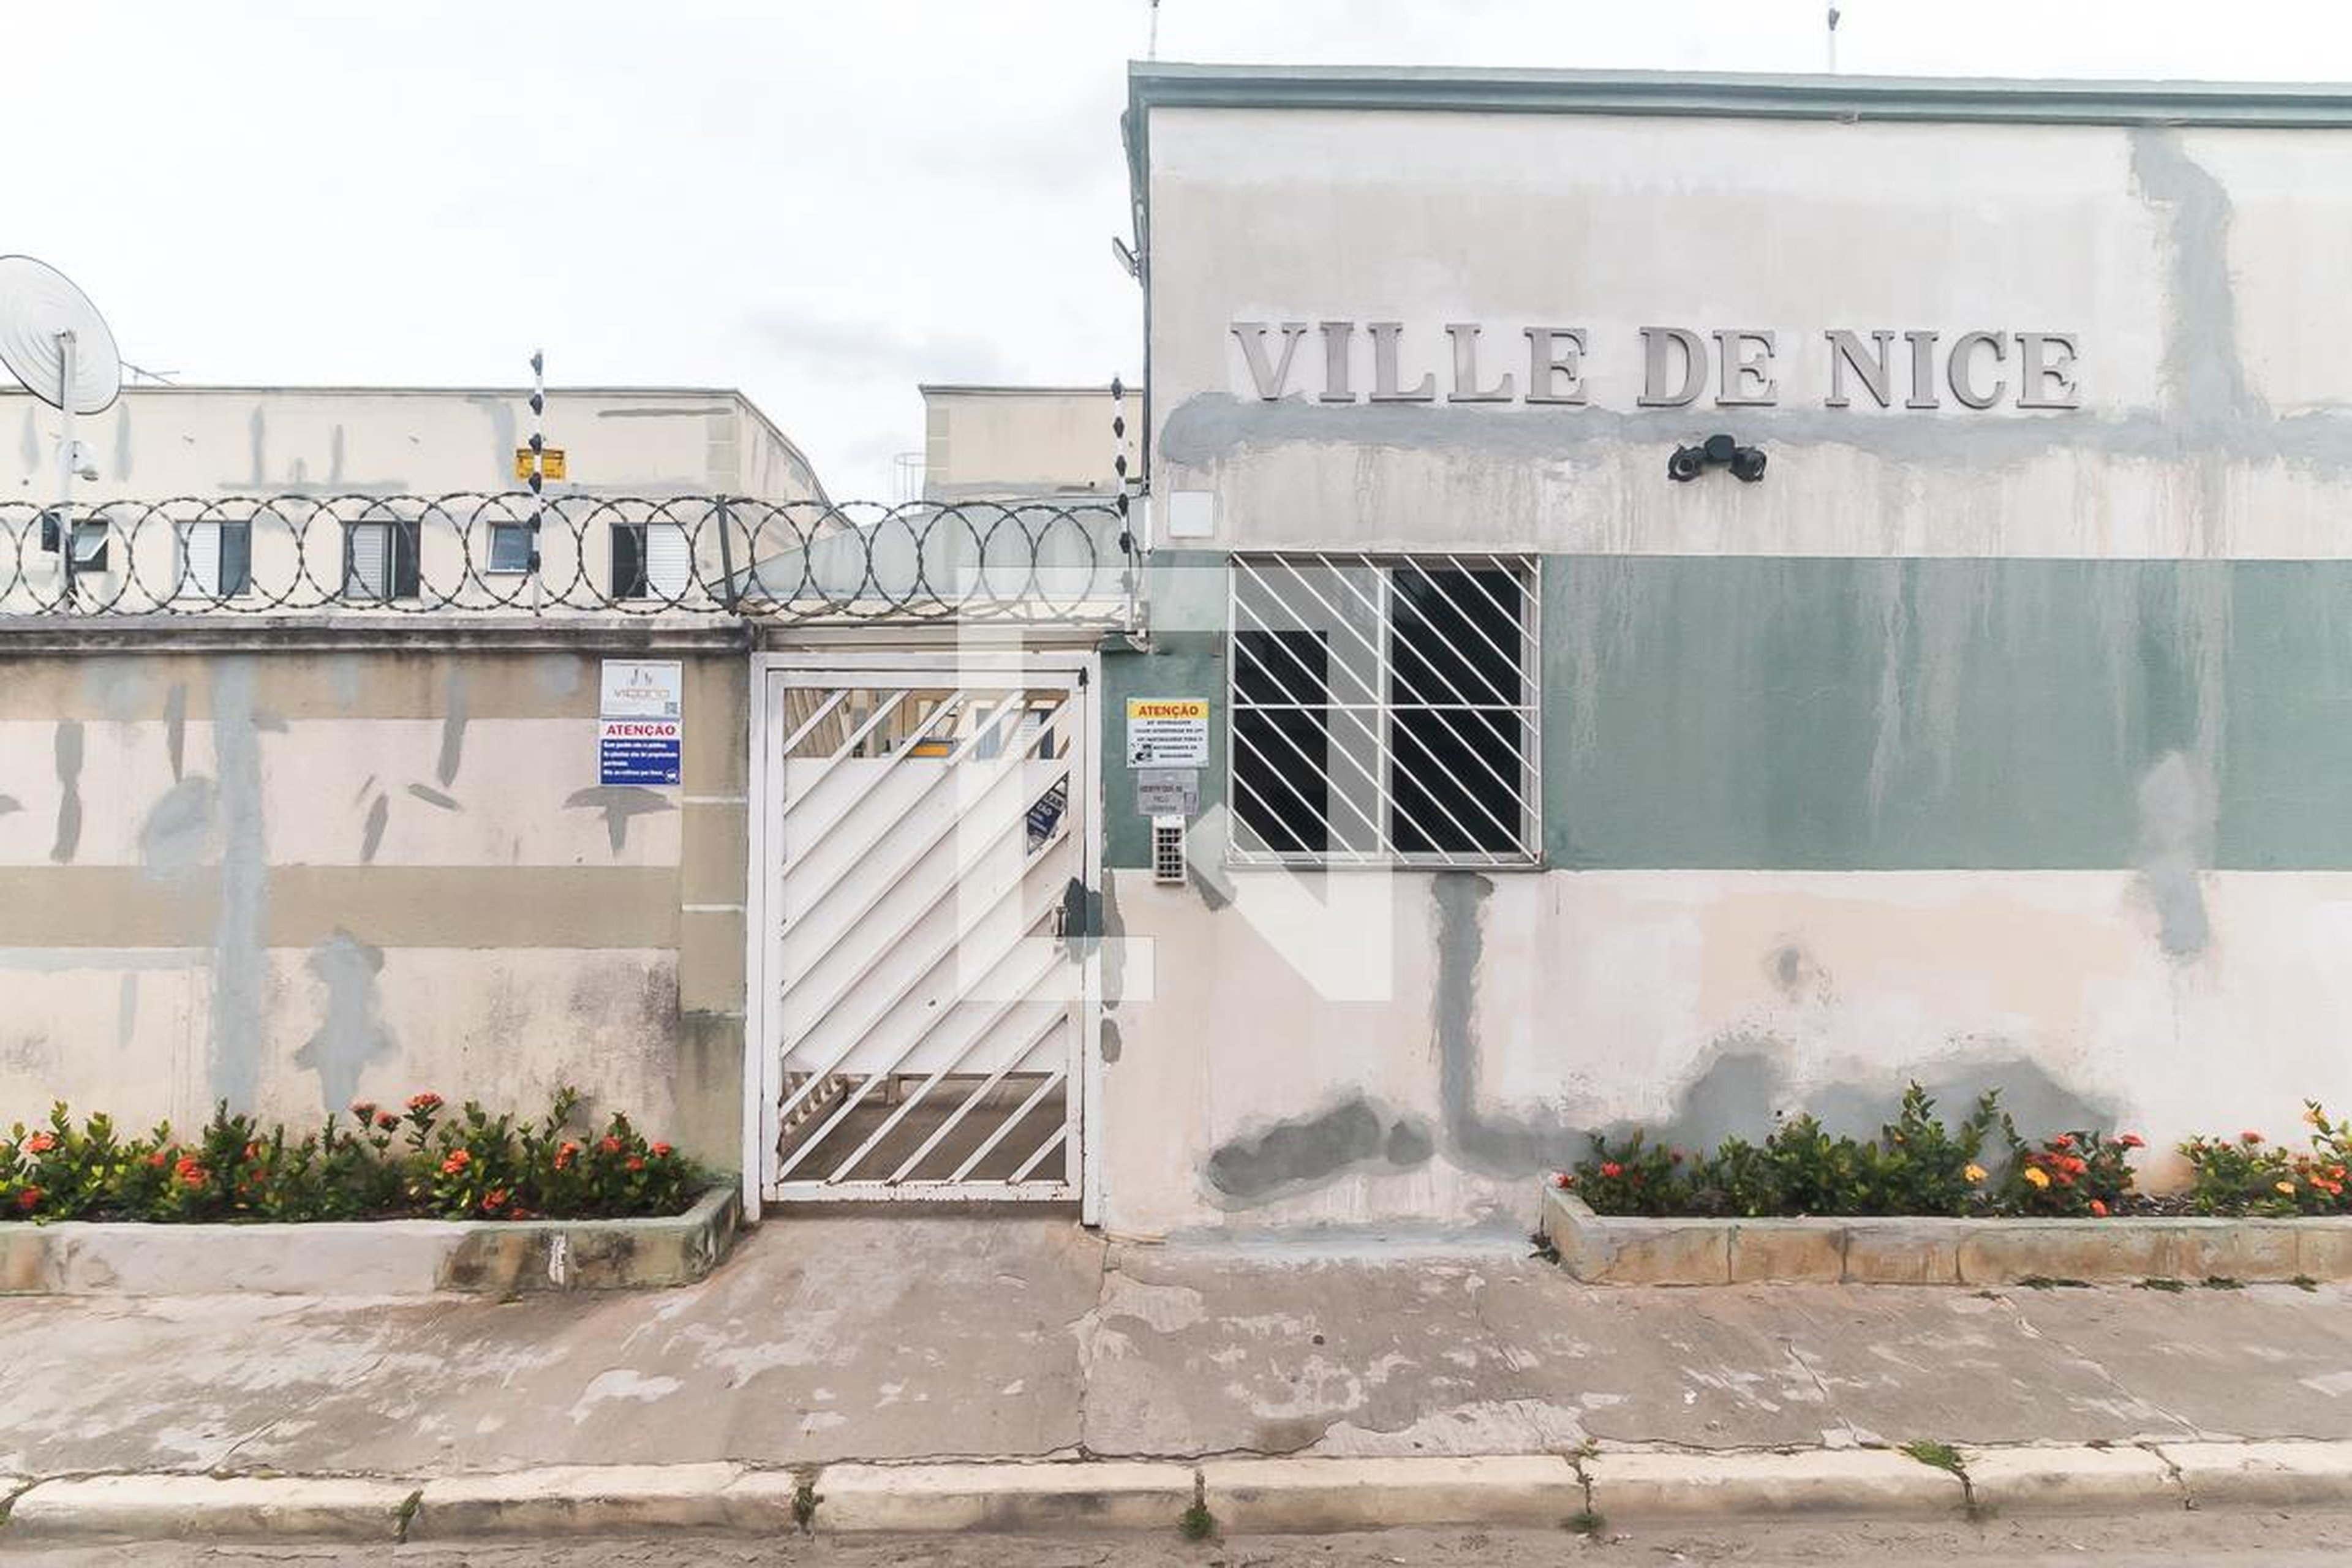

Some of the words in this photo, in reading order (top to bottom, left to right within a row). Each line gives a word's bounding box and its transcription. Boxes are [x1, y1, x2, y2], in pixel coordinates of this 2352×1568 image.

[1231, 322, 1587, 404] VILLE
[1637, 326, 1776, 407] DE
[1825, 330, 2080, 409] NICE
[1139, 703, 1199, 718] ATENÇÃO
